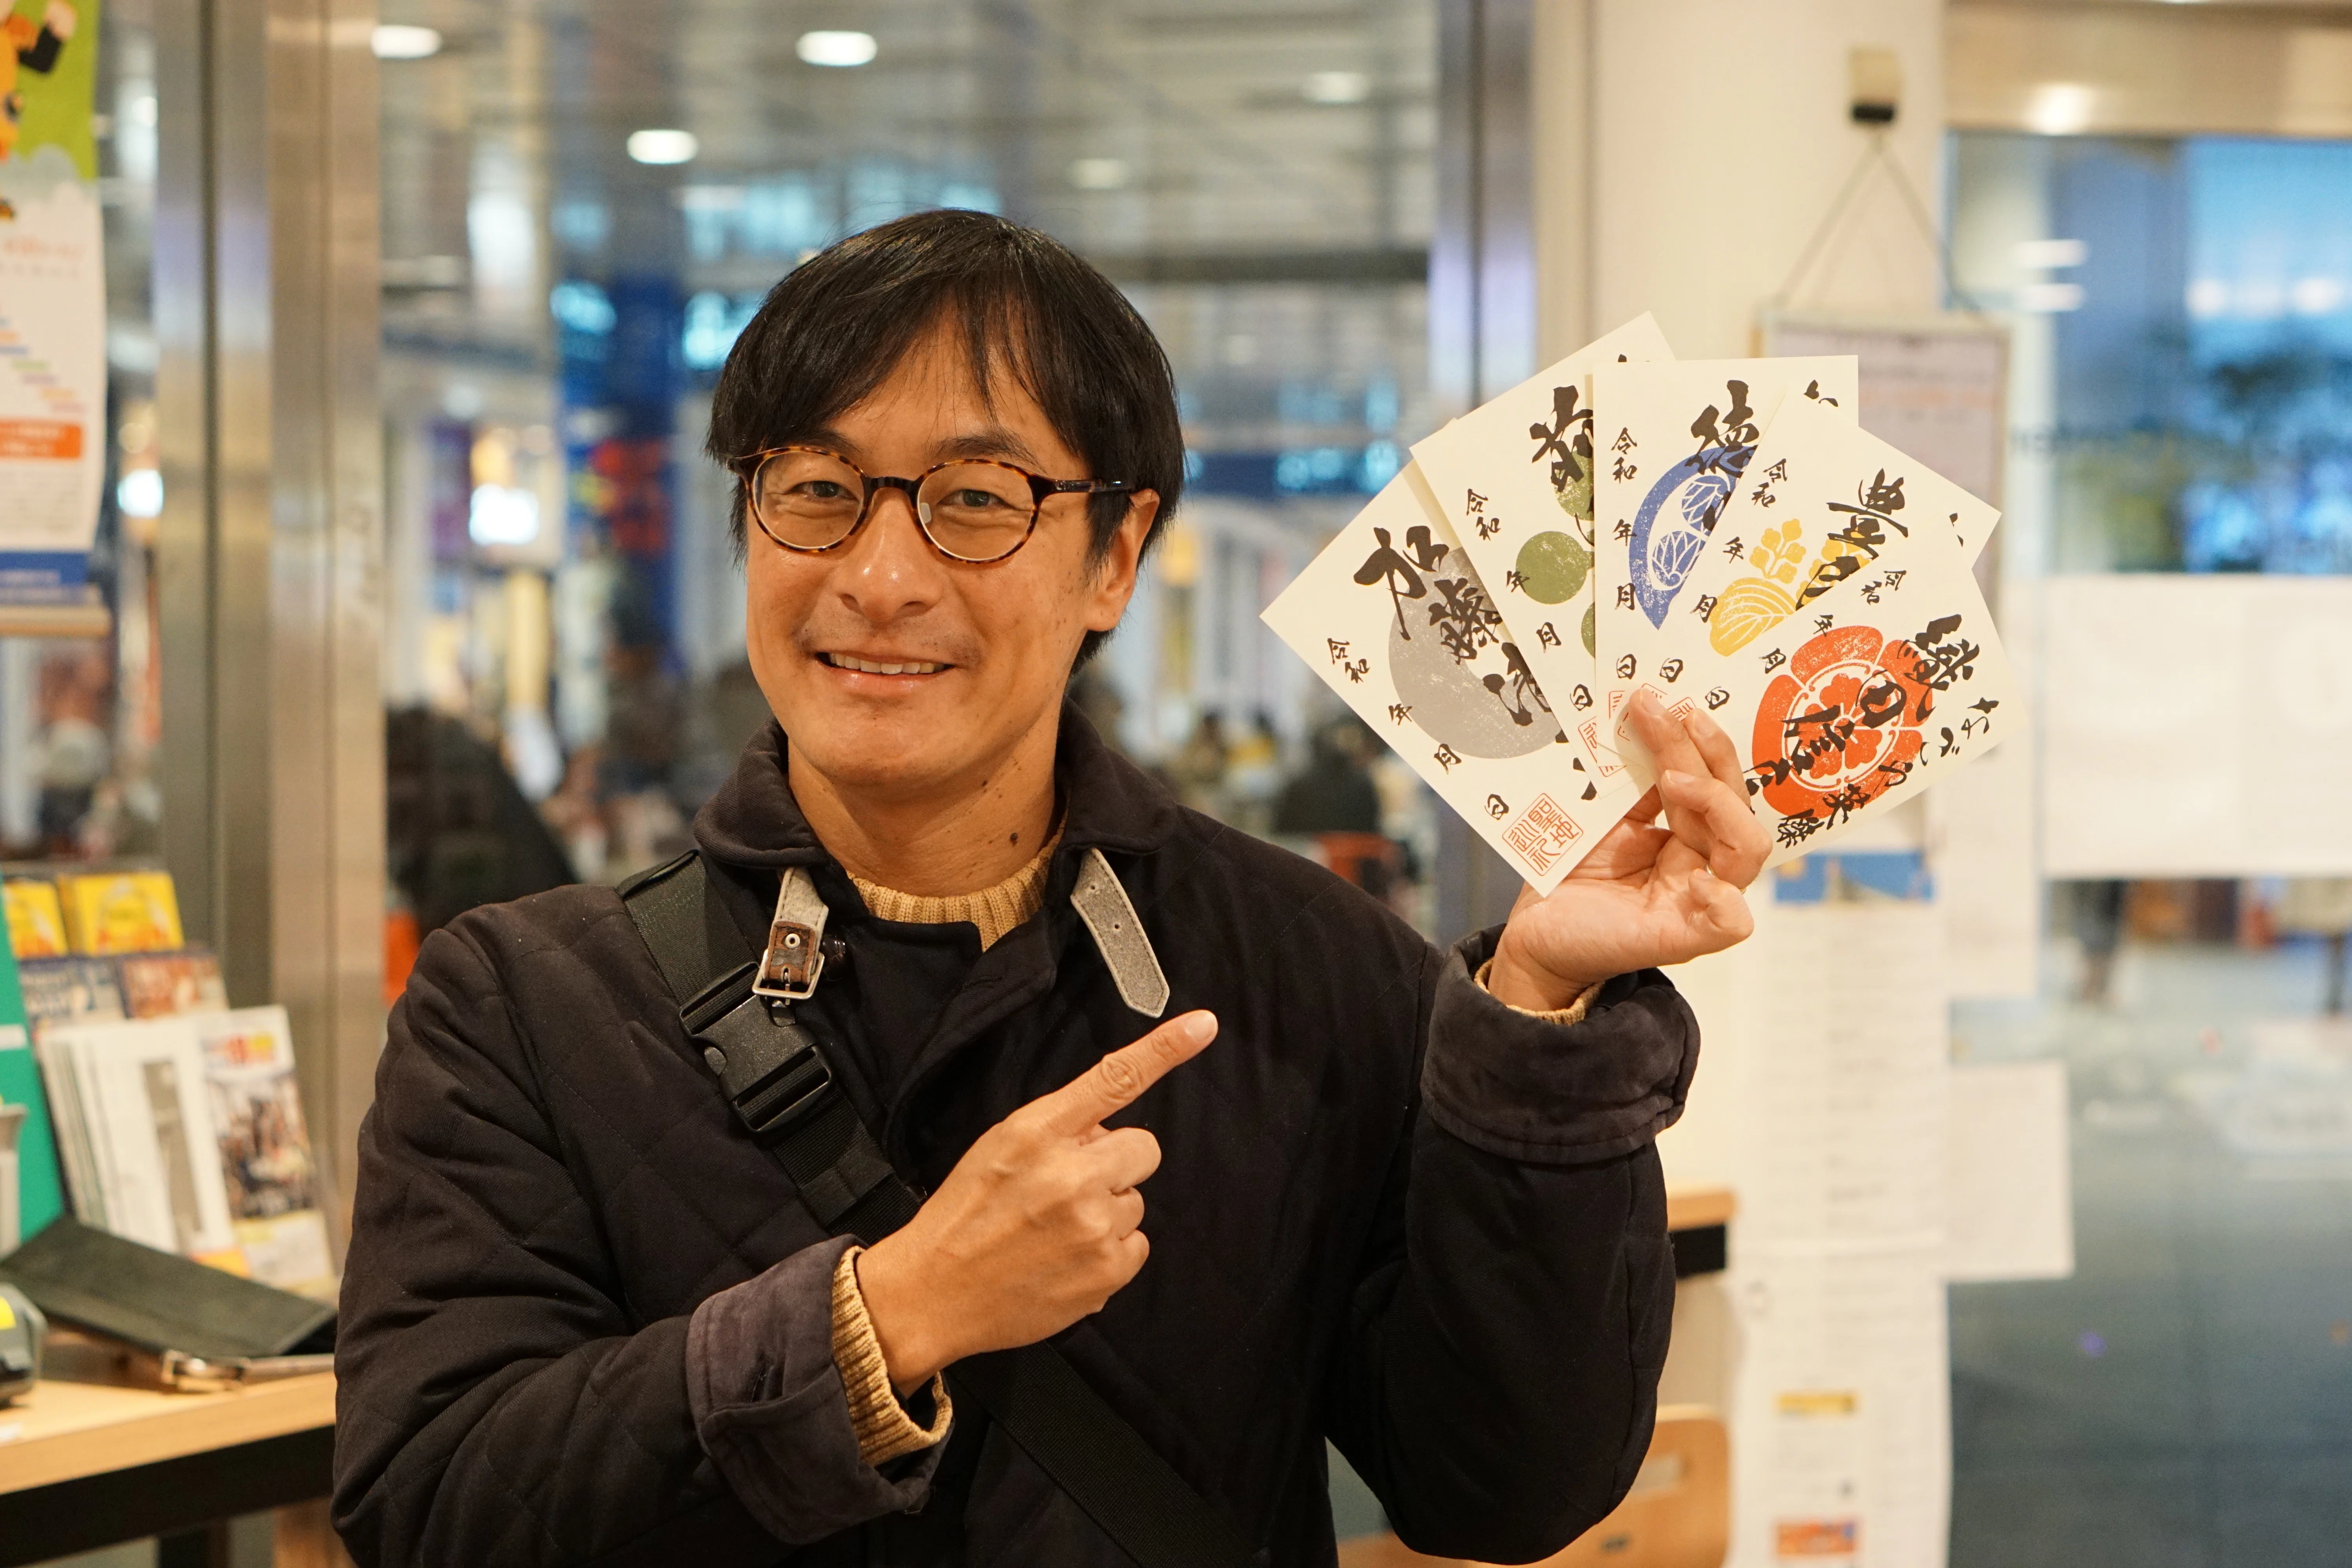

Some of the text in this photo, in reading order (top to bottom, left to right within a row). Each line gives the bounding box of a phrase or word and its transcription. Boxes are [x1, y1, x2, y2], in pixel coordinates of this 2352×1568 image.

[1610, 427, 1638, 484] 令和
[1751, 458, 1788, 508] 令和
[1612, 519, 1637, 546] 年
[1722, 536, 1744, 564] 年
[1466, 488, 1593, 711] 令和 年 月 日
[1615, 582, 1635, 611] 月
[1860, 569, 1907, 605] 令和
[1691, 594, 1718, 623] 月
[1813, 614, 1834, 637] 年
[1354, 525, 1597, 800] 加藤清
[1616, 654, 1637, 680] 日
[1658, 657, 1684, 683] 日
[1759, 648, 1787, 674] 月
[1705, 686, 1730, 711] 日
[1327, 637, 1509, 820] 令和 年 月 日
